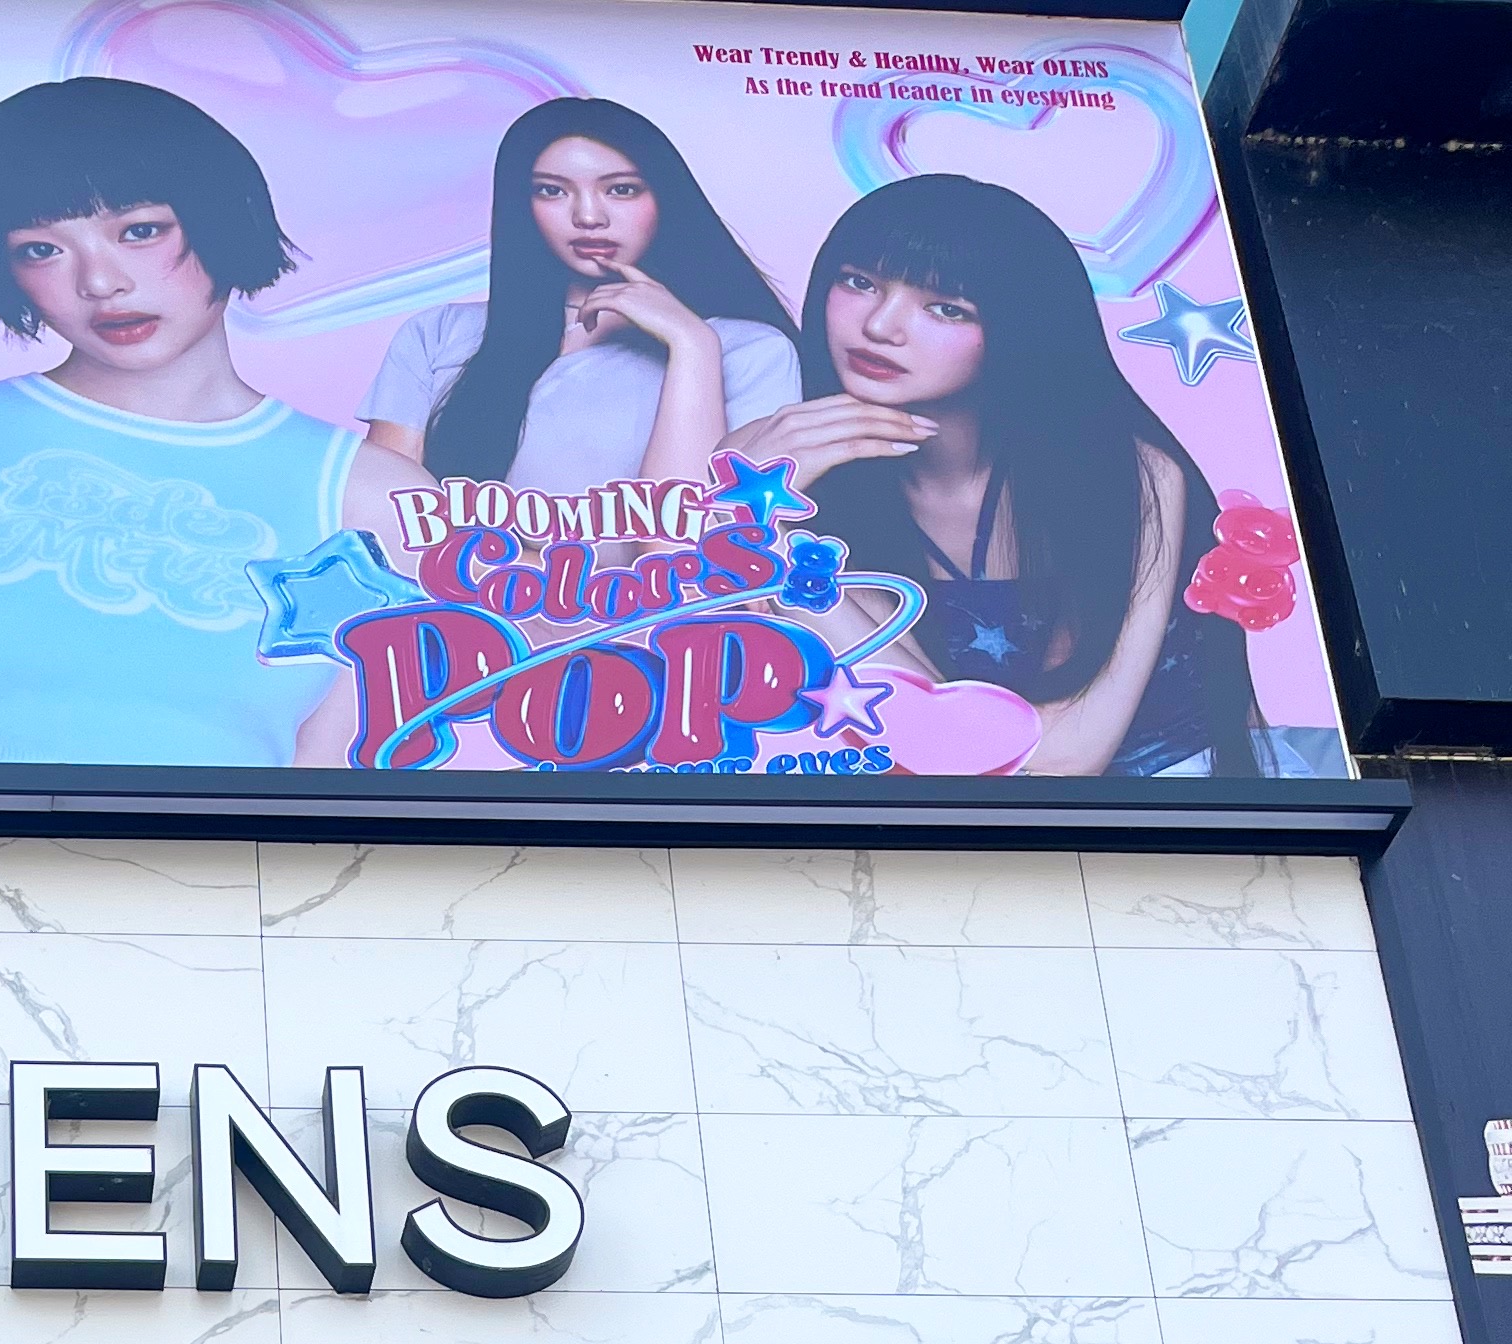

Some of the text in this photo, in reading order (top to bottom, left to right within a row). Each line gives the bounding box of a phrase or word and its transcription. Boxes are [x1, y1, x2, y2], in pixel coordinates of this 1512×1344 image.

[692, 44, 1110, 79] Wear Trendy & Healthy, Wear OLENS
[744, 76, 1116, 112] As the trend leader in eyestyling
[391, 480, 708, 552] BLOOMING
[338, 604, 818, 770] POP
